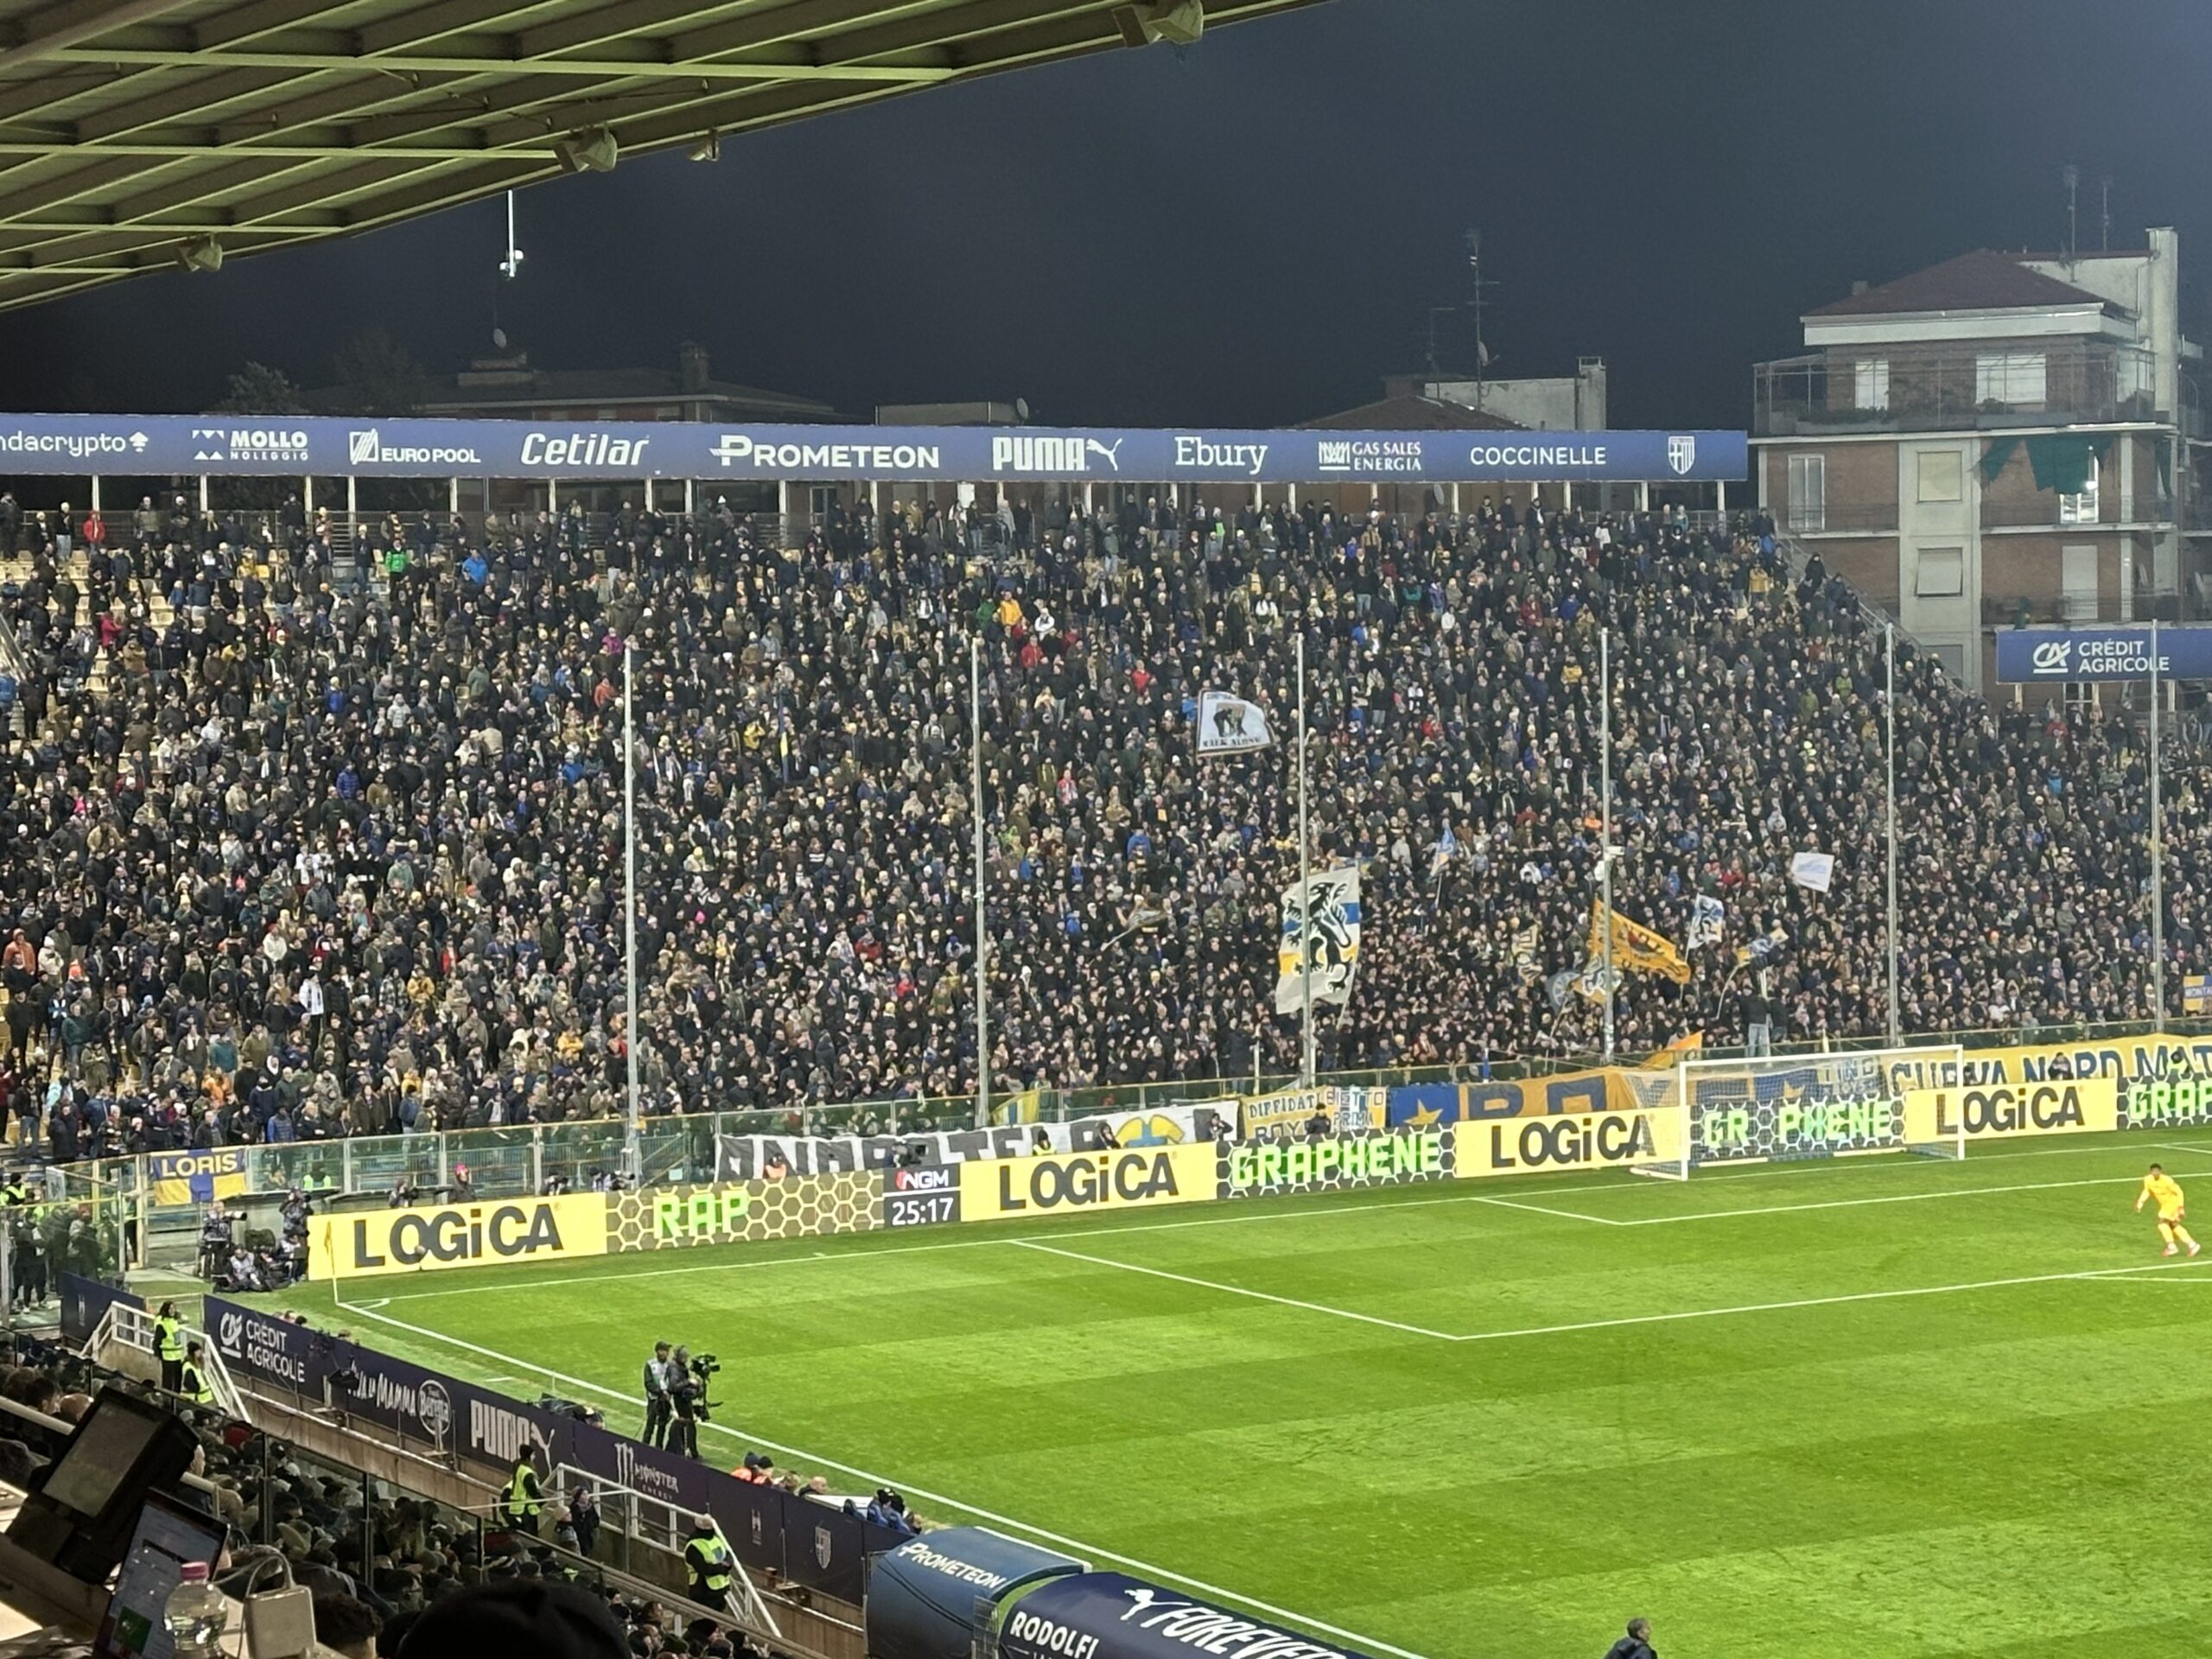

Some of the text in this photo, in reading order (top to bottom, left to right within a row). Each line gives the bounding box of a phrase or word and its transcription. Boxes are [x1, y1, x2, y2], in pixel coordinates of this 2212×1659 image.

[230, 430, 308, 448] MOLLO
[520, 432, 650, 466] Cetilar
[709, 434, 939, 467] PROMETEON
[1351, 442, 1421, 455] GAS SALES
[230, 451, 309, 461] NOLEGGIO
[993, 436, 1087, 471] PUMA
[1174, 436, 1268, 475] Ebury
[1354, 457, 1422, 471] ENERGIA
[1471, 447, 1606, 465] COCCINELLE
[2078, 638, 2145, 657] CRÉDIT
[2078, 657, 2170, 673] AGRICOLE
[2023, 1051, 2123, 1083] NRD
[1249, 1092, 1320, 1118] DIFFIDATI
[162, 1154, 237, 1178] LORIS
[1231, 1132, 1444, 1188] GRAPHENE
[901, 1169, 949, 1190] NGM
[652, 1188, 750, 1239] RAP
[892, 1198, 954, 1225] 25:17
[246, 1318, 288, 1346] CRÉDIT
[246, 1344, 305, 1382] AGRICOLE
[897, 1541, 1007, 1589] PROMETEON
[1010, 1611, 1100, 1659] RODOLFI
[1140, 1606, 1348, 1659] FOREVE
